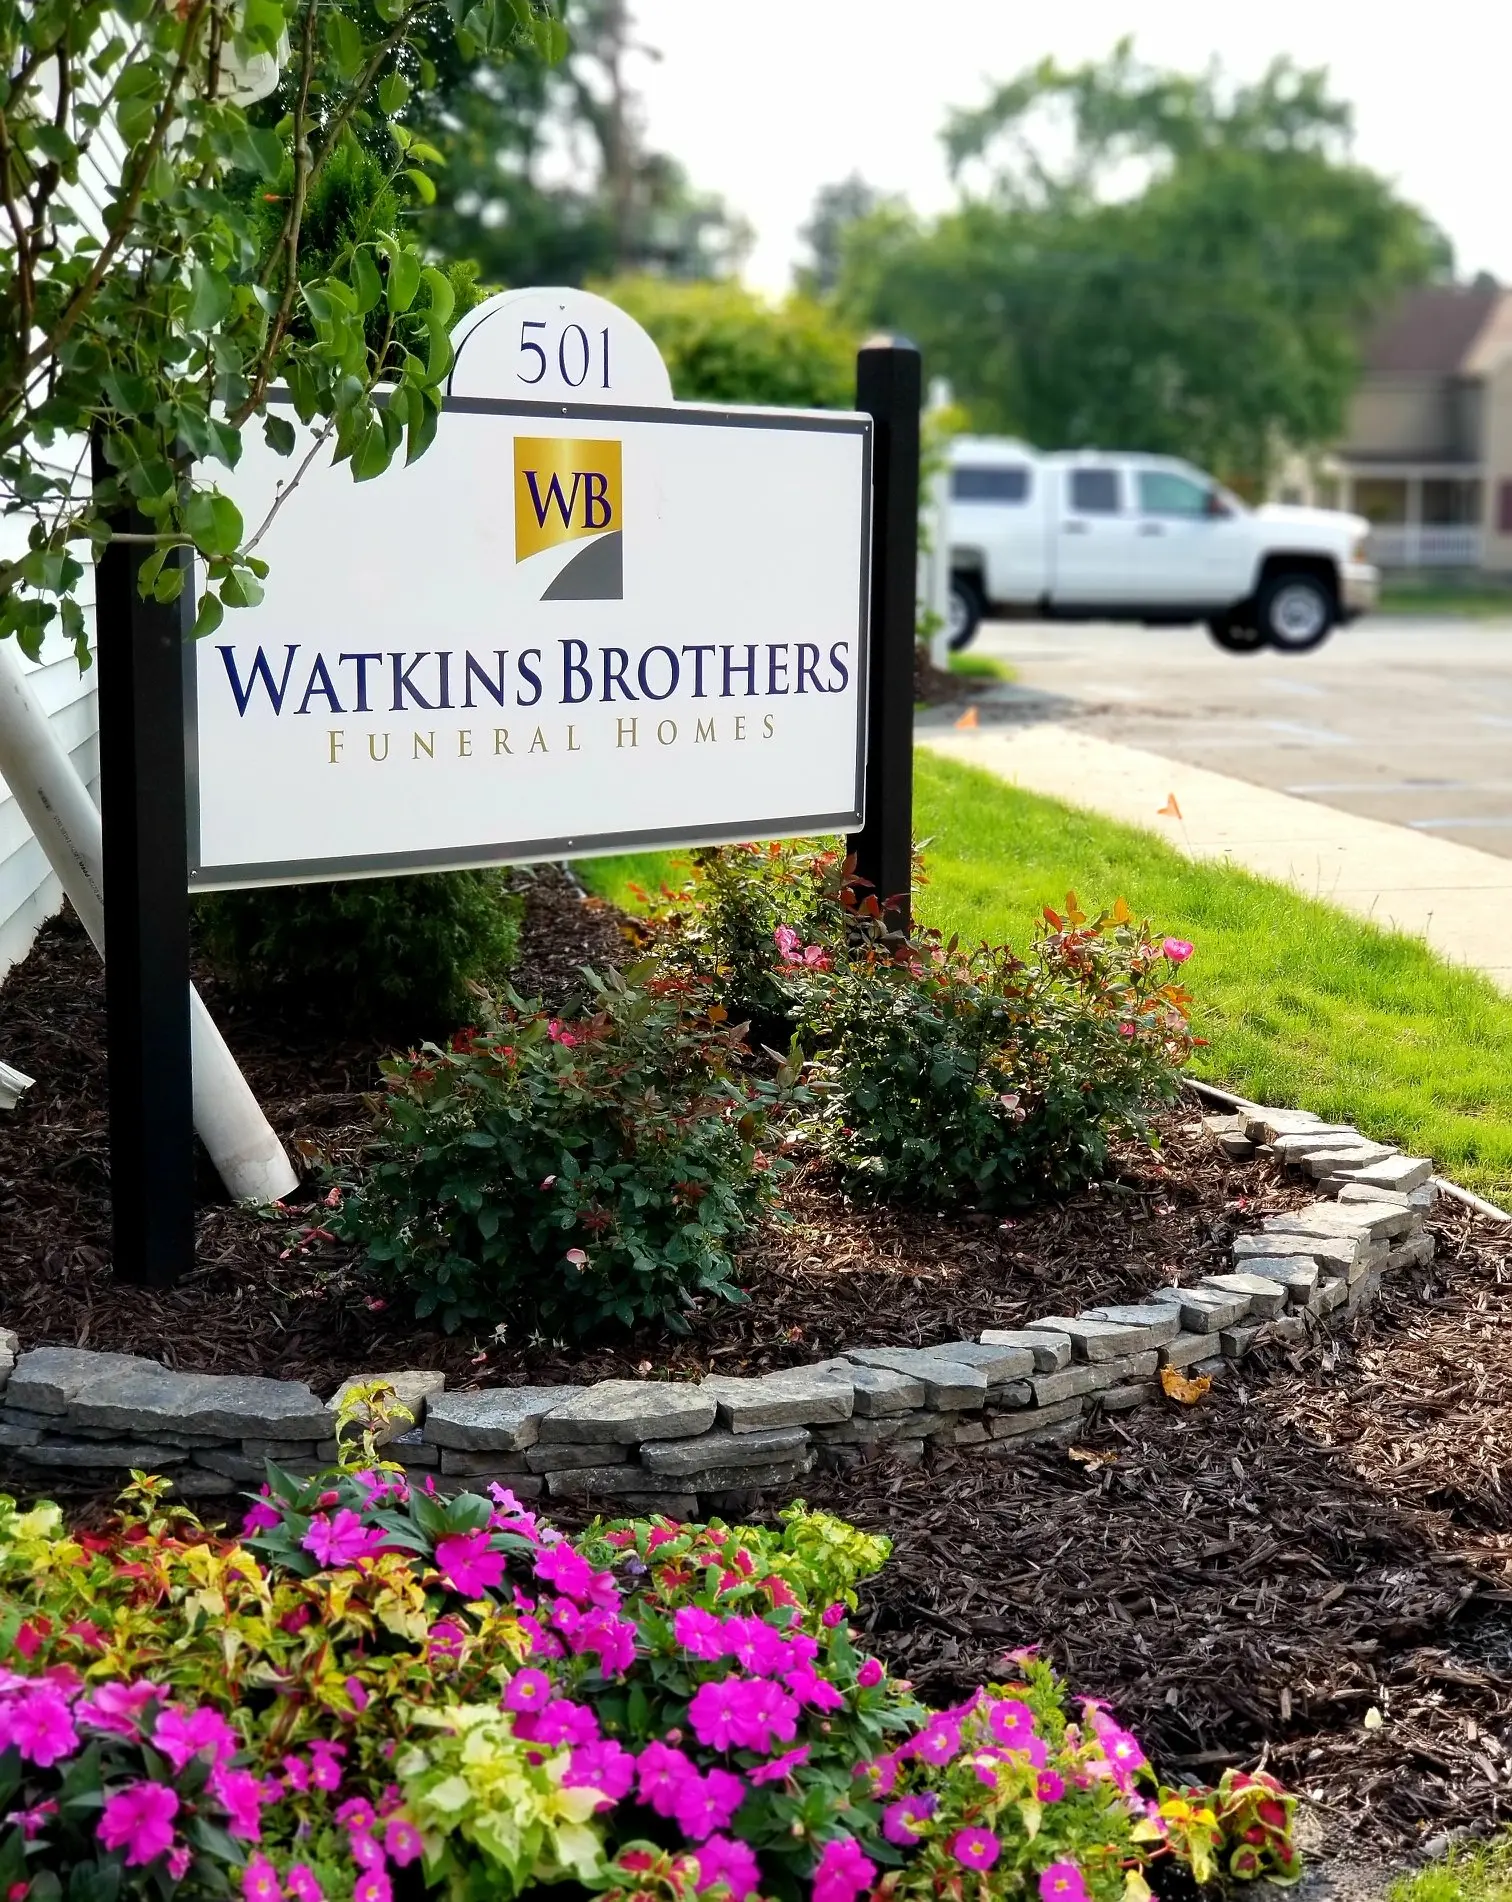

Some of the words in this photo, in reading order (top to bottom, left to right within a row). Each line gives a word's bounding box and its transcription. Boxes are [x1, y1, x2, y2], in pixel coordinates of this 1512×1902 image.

[516, 320, 612, 389] 501
[521, 470, 612, 530] WB
[214, 644, 543, 718] WATKINS
[557, 638, 850, 704] BROTHERS
[326, 724, 582, 764] FUNERAL
[616, 713, 775, 748] HOMES
